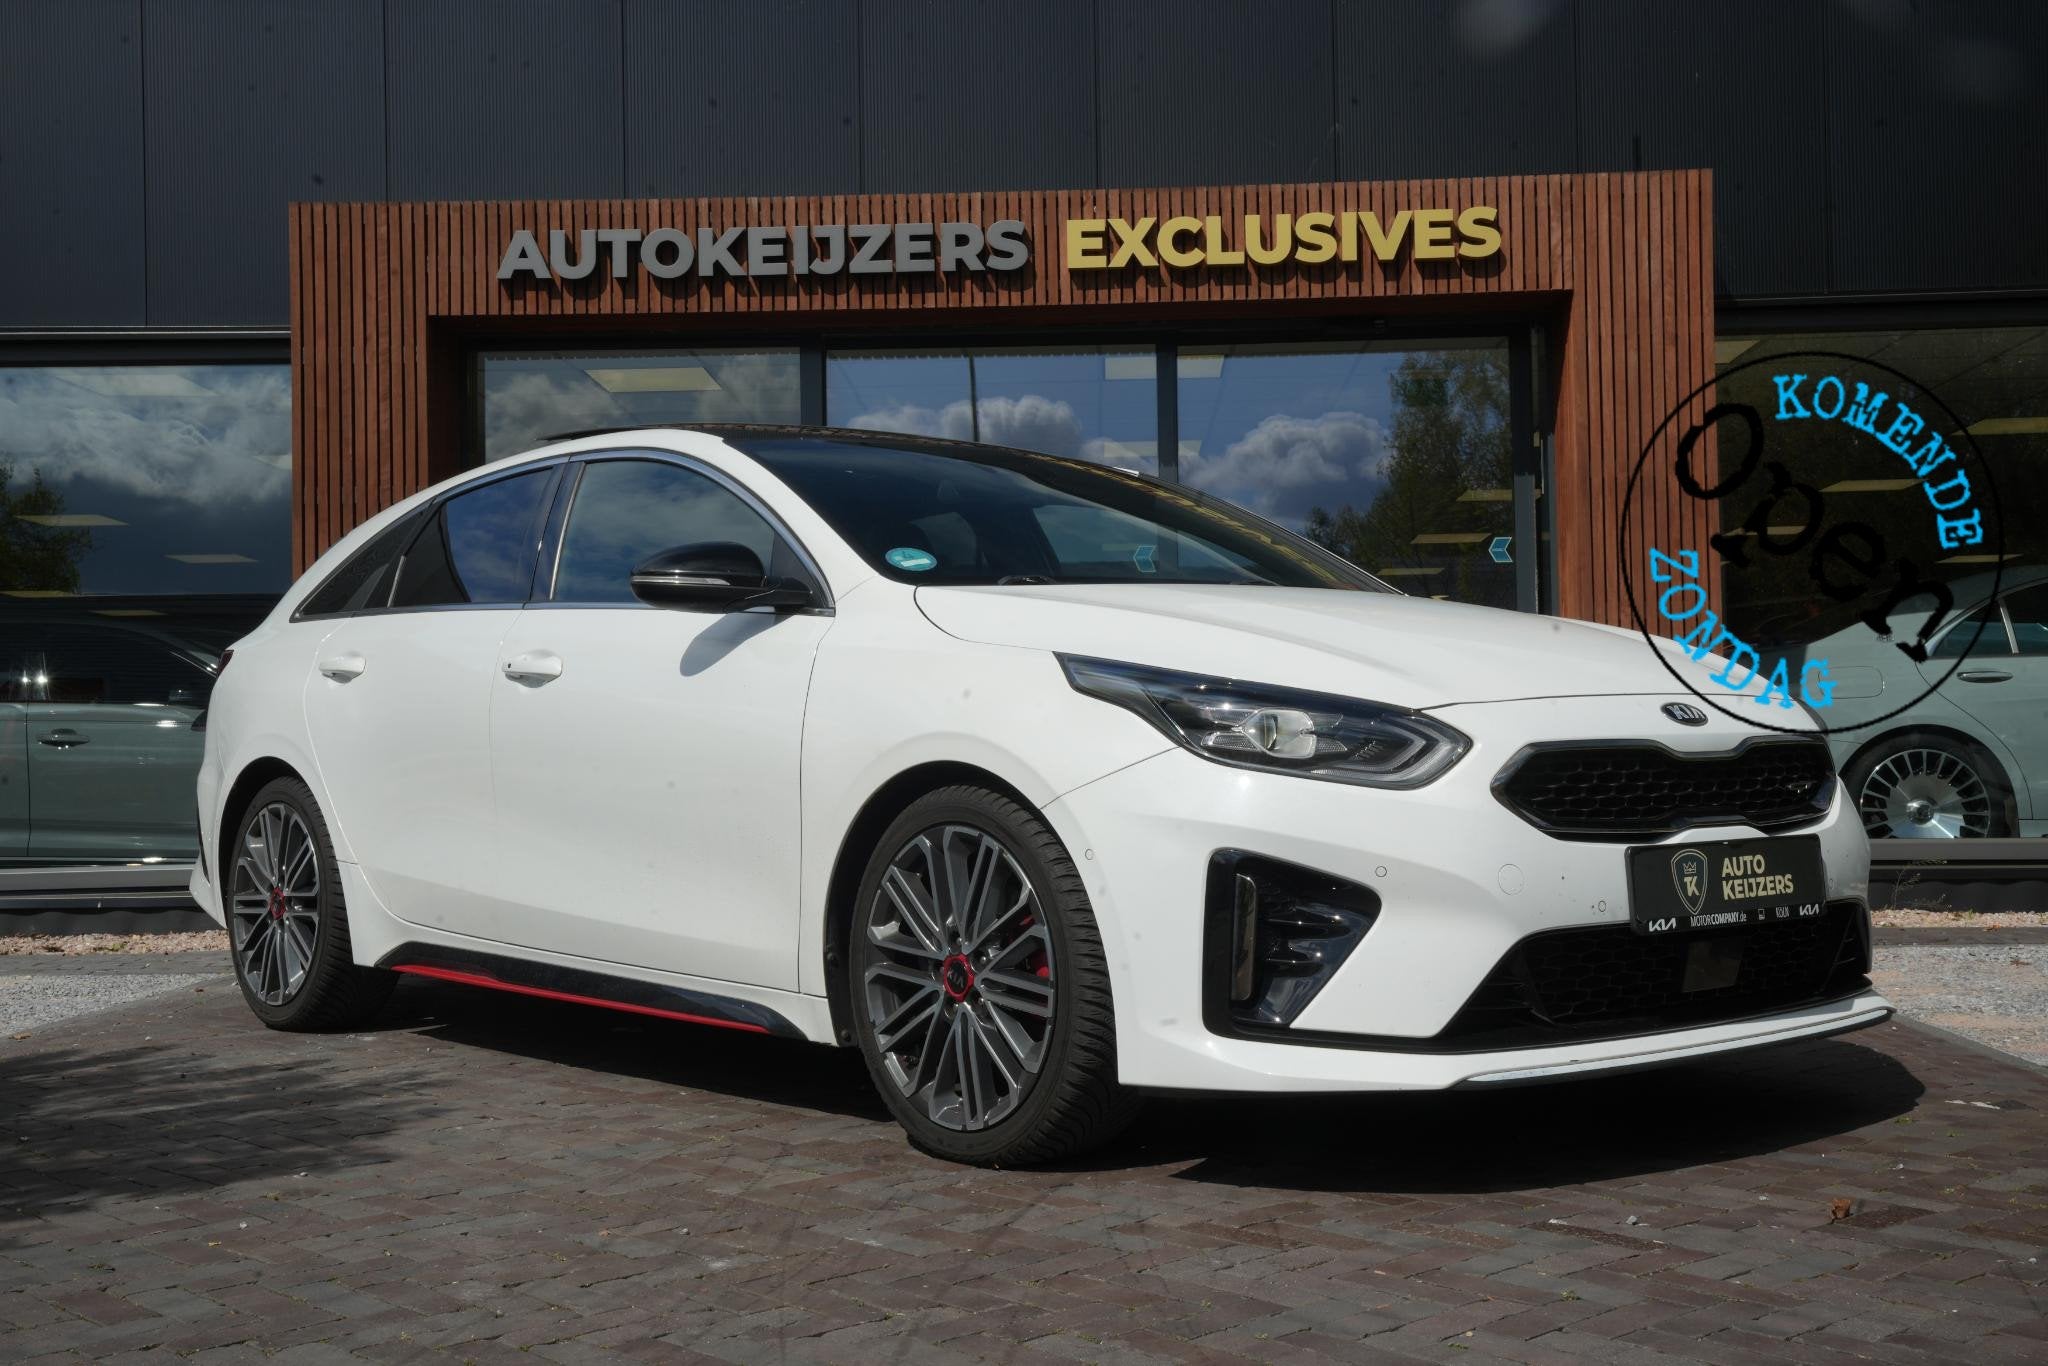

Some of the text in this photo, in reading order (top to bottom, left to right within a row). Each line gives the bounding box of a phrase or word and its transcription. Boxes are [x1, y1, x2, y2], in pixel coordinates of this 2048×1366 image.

[496, 206, 1502, 281] AUTOKEIJZERS EXCLUSIVES
[1721, 854, 1766, 878] AUTO
[1722, 873, 1795, 901] KEIJZERS
[1648, 917, 1677, 932] KIA
[1799, 903, 1820, 916] KIA
